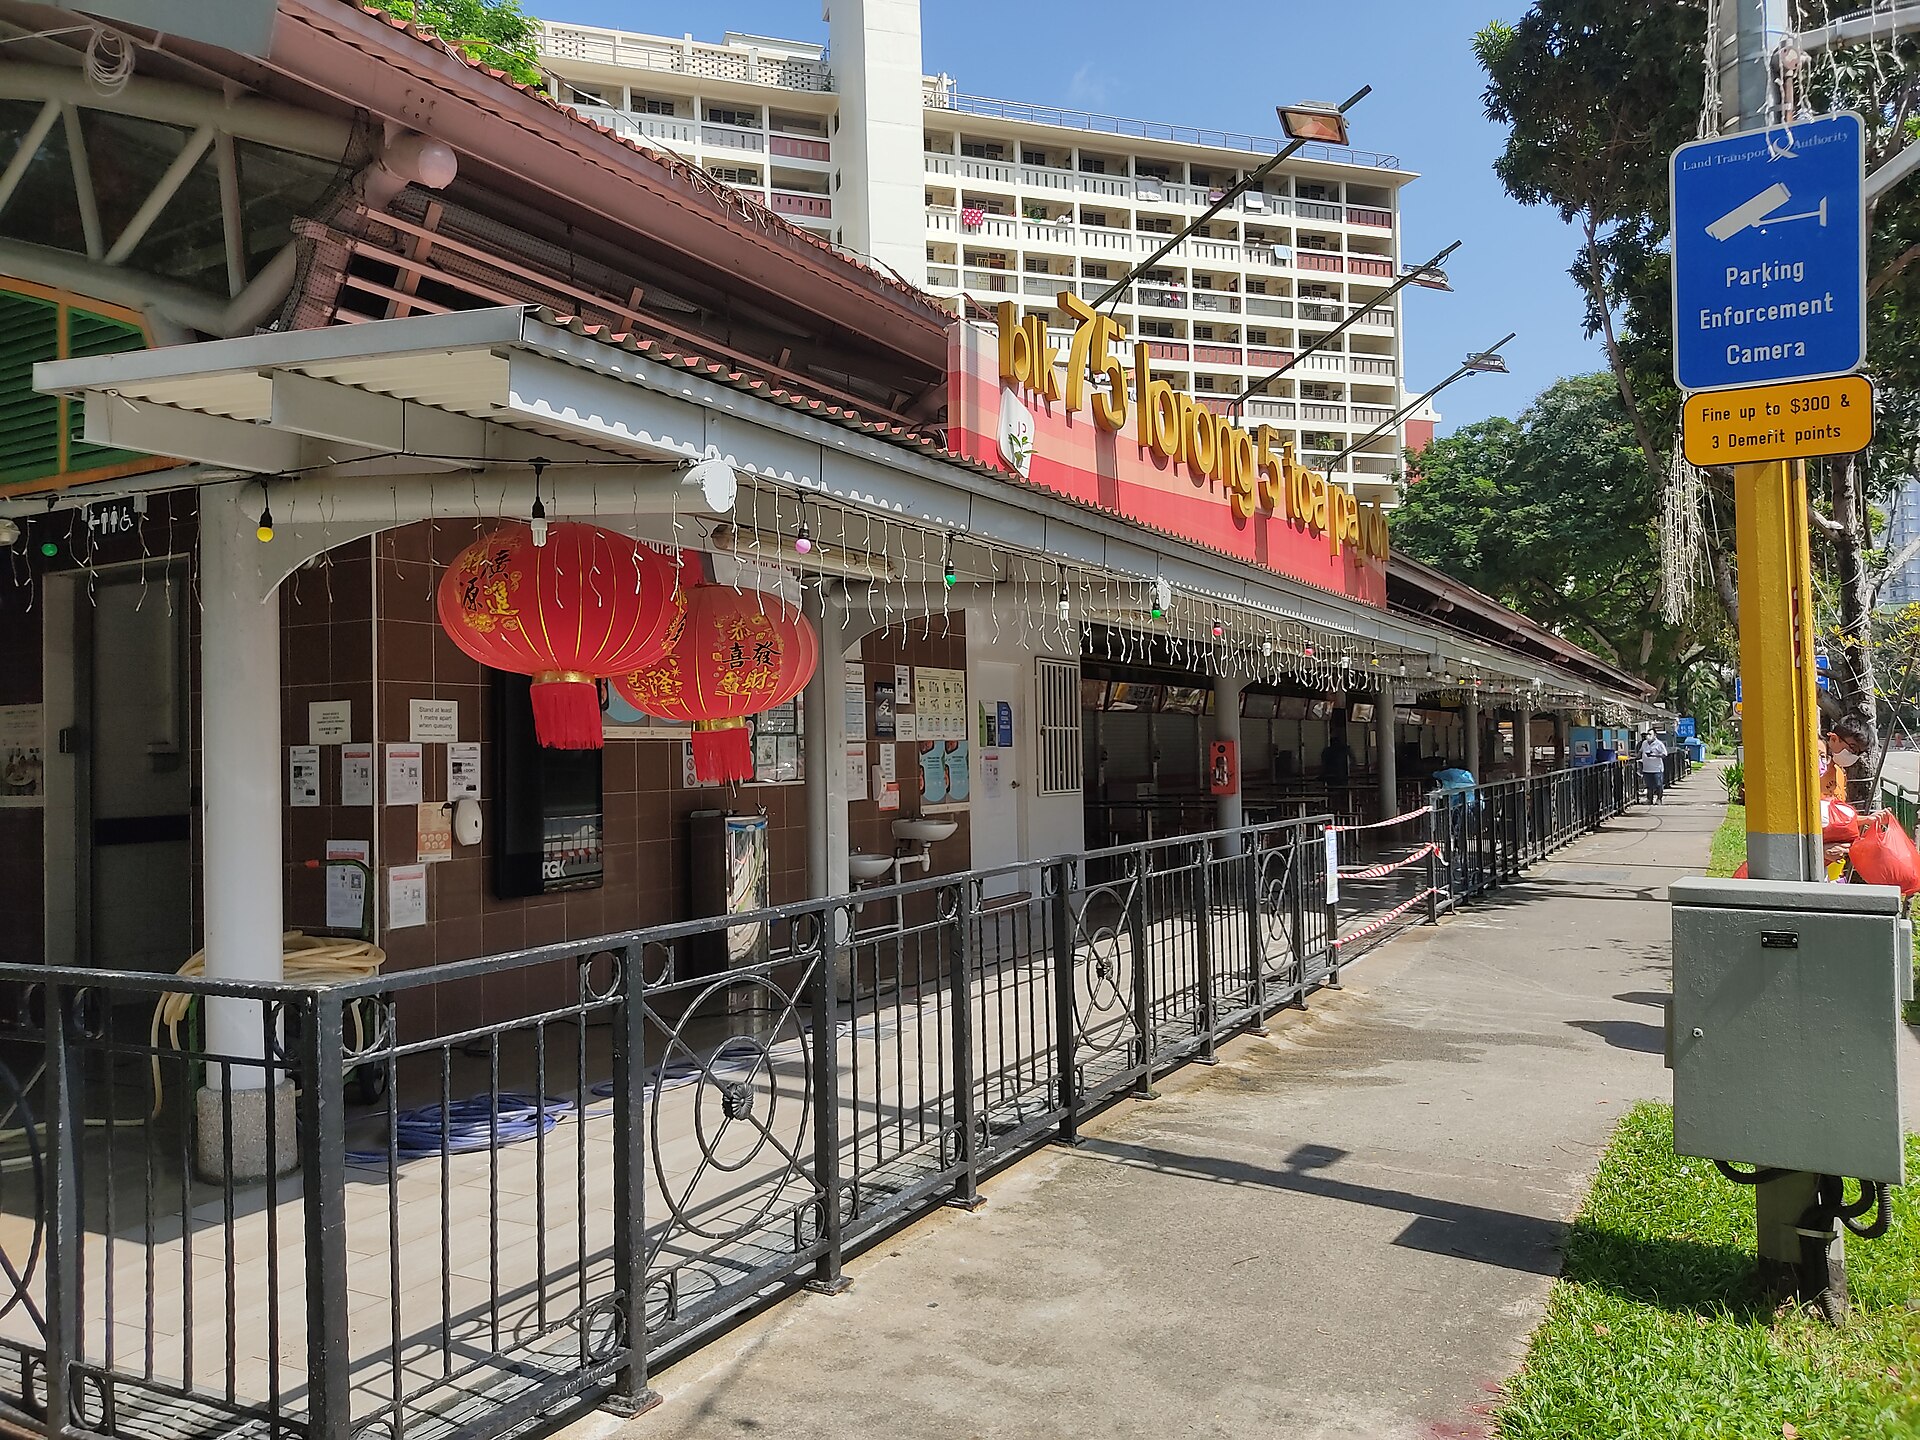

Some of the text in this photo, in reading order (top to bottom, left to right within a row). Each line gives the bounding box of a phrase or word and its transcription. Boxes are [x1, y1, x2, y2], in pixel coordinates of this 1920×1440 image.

[1683, 157, 1712, 171] Land
[1793, 131, 1849, 150] Authority
[1726, 260, 1804, 287] Parking
[1700, 292, 1834, 330] Enforcement
[1726, 341, 1805, 365] Camera
[999, 301, 1061, 402] blk
[1057, 291, 1128, 431] 75
[1134, 342, 1255, 519] lorong
[1257, 424, 1282, 512] 5
[1282, 440, 1328, 532] toa
[1702, 393, 1850, 422] Fine up to $300 &
[1712, 424, 1841, 449] 3 Demerit points
